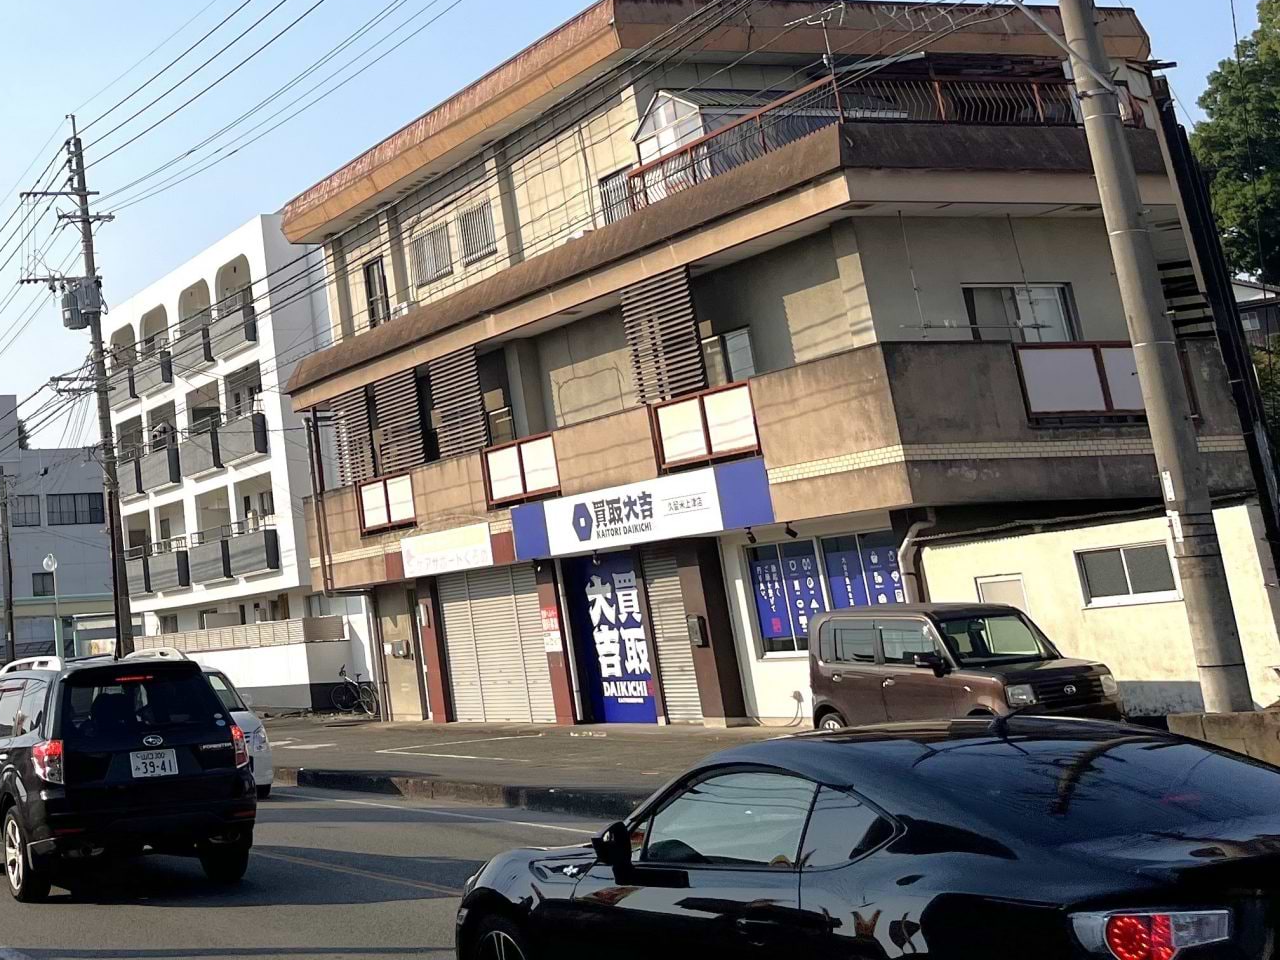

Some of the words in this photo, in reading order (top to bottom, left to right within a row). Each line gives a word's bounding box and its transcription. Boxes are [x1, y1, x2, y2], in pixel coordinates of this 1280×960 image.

[592, 491, 653, 528] 買取大吉
[596, 526, 622, 539] KAITORI
[623, 522, 652, 534] DAIKICHI
[612, 570, 651, 675] 買取
[602, 680, 648, 697] DAIKICHI
[142, 760, 172, 774] 39-41
